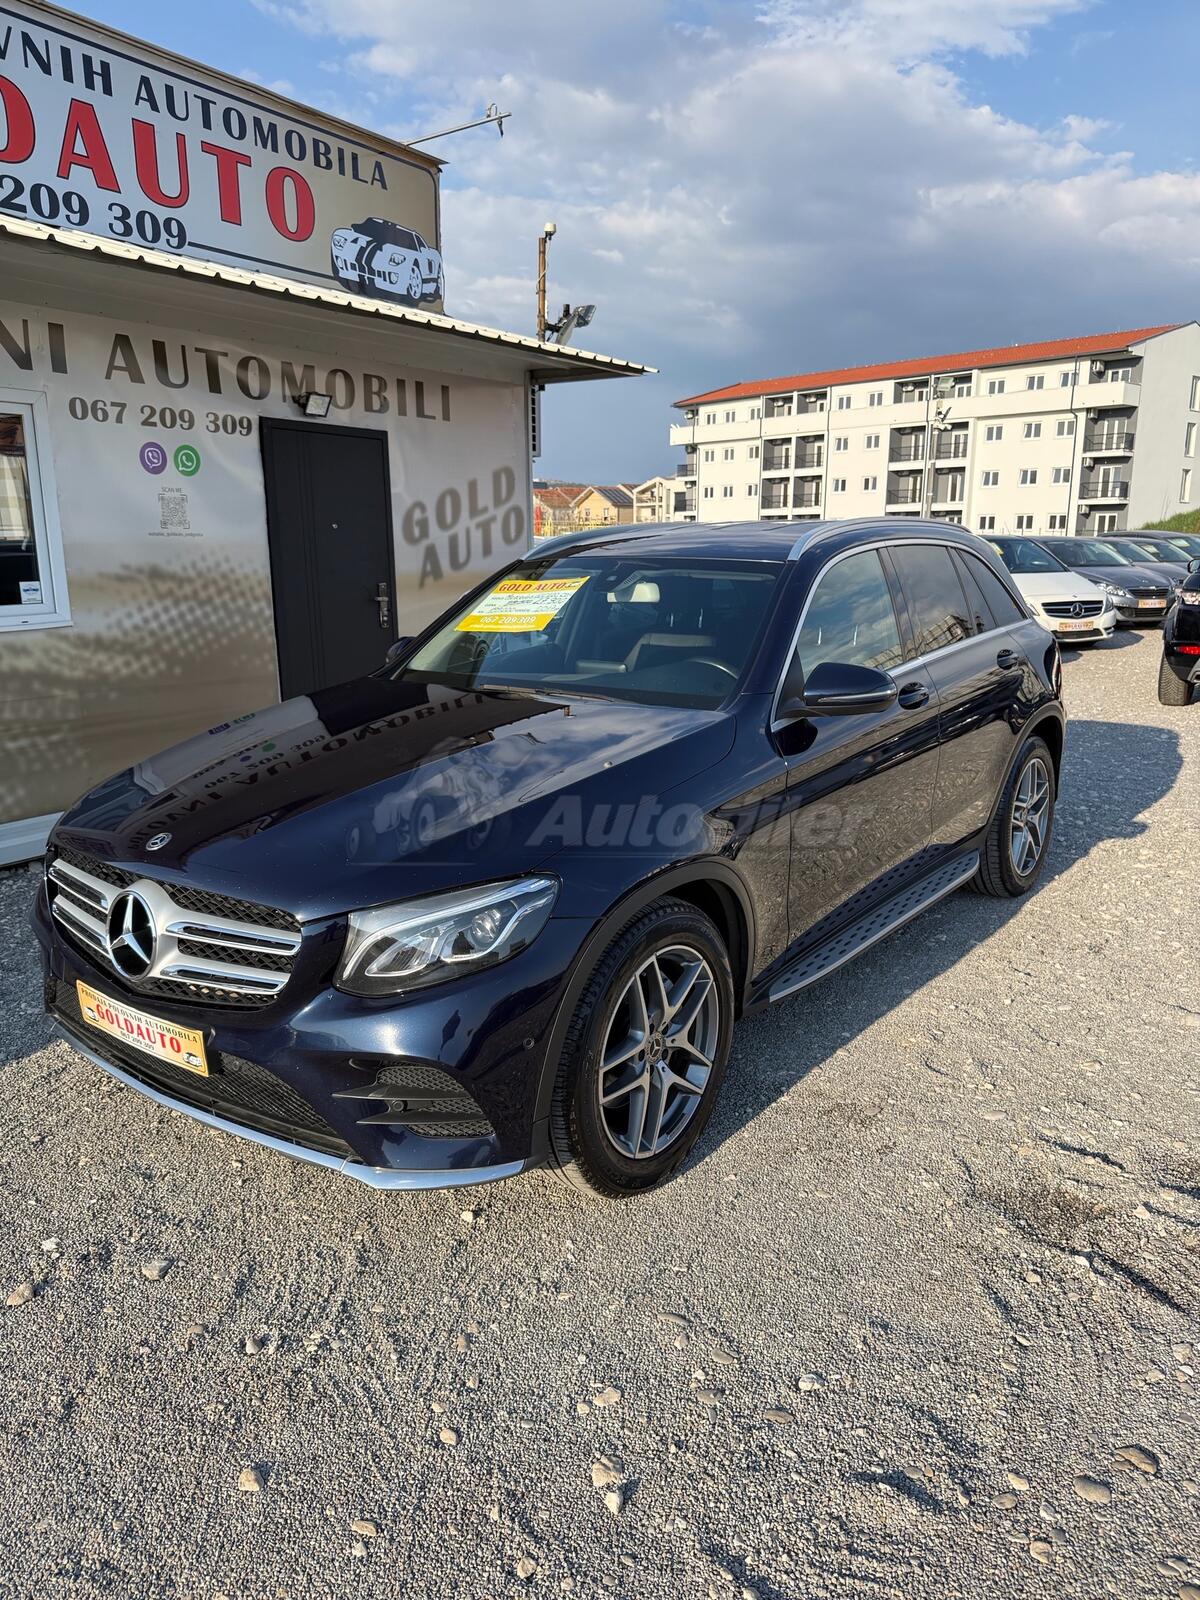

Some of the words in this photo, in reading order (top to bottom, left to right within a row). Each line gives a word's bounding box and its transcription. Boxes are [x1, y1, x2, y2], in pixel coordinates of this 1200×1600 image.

[134, 74, 389, 191] AUTOMOBILA
[0, 174, 90, 227] 209
[107, 202, 189, 250] 309
[105, 333, 452, 423] AUTOMOBILI
[68, 396, 128, 426] 067
[140, 405, 196, 431] 209
[206, 411, 254, 437] 309
[402, 465, 516, 547] GOLD
[418, 504, 525, 591] AUTO
[499, 583, 532, 592] GOLD
[534, 582, 566, 591] AUTO
[96, 1003, 182, 1054] GOLDAUTO
[144, 1018, 198, 1044] AUTOMOBILA
